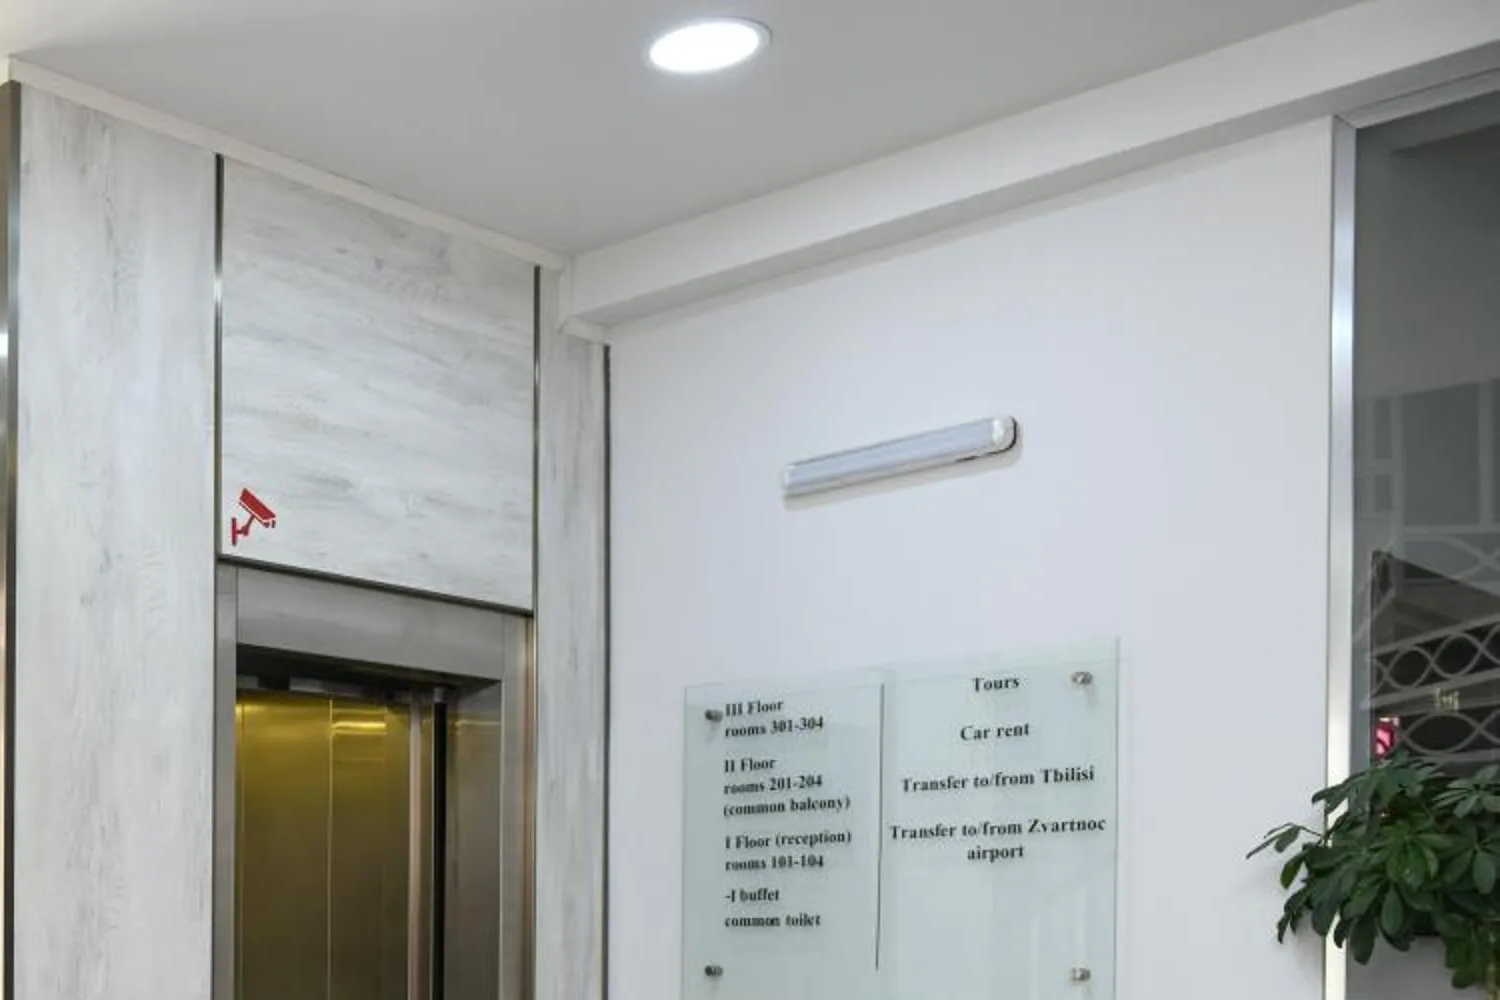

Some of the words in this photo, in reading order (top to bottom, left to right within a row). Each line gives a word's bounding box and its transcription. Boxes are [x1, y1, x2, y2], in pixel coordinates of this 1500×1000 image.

[972, 675, 1020, 693] Tours
[725, 703, 743, 717] III
[747, 700, 784, 715] Floor
[725, 726, 767, 737] rooms
[770, 716, 823, 734] 301-304
[960, 726, 991, 741] Car
[996, 723, 1030, 738] rent
[740, 758, 777, 772] Floor
[724, 782, 765, 795] rooms
[769, 774, 822, 791] 201-204
[902, 774, 969, 793] Transfer
[973, 771, 1035, 789] to/from
[1041, 765, 1095, 784] Tbilisi
[723, 801, 786, 817] (common
[789, 795, 851, 813] balcony)
[891, 823, 957, 840] Transfer
[961, 821, 1023, 837] to/from
[1028, 817, 1106, 835] Zvartnoc
[735, 835, 771, 849] Floor
[775, 830, 852, 848] (reception)
[725, 859, 766, 871] rooms
[771, 854, 824, 869] 101-104
[967, 845, 1025, 863] airport
[739, 887, 780, 902] buffet
[724, 916, 780, 927] common
[785, 912, 821, 927] toilet
